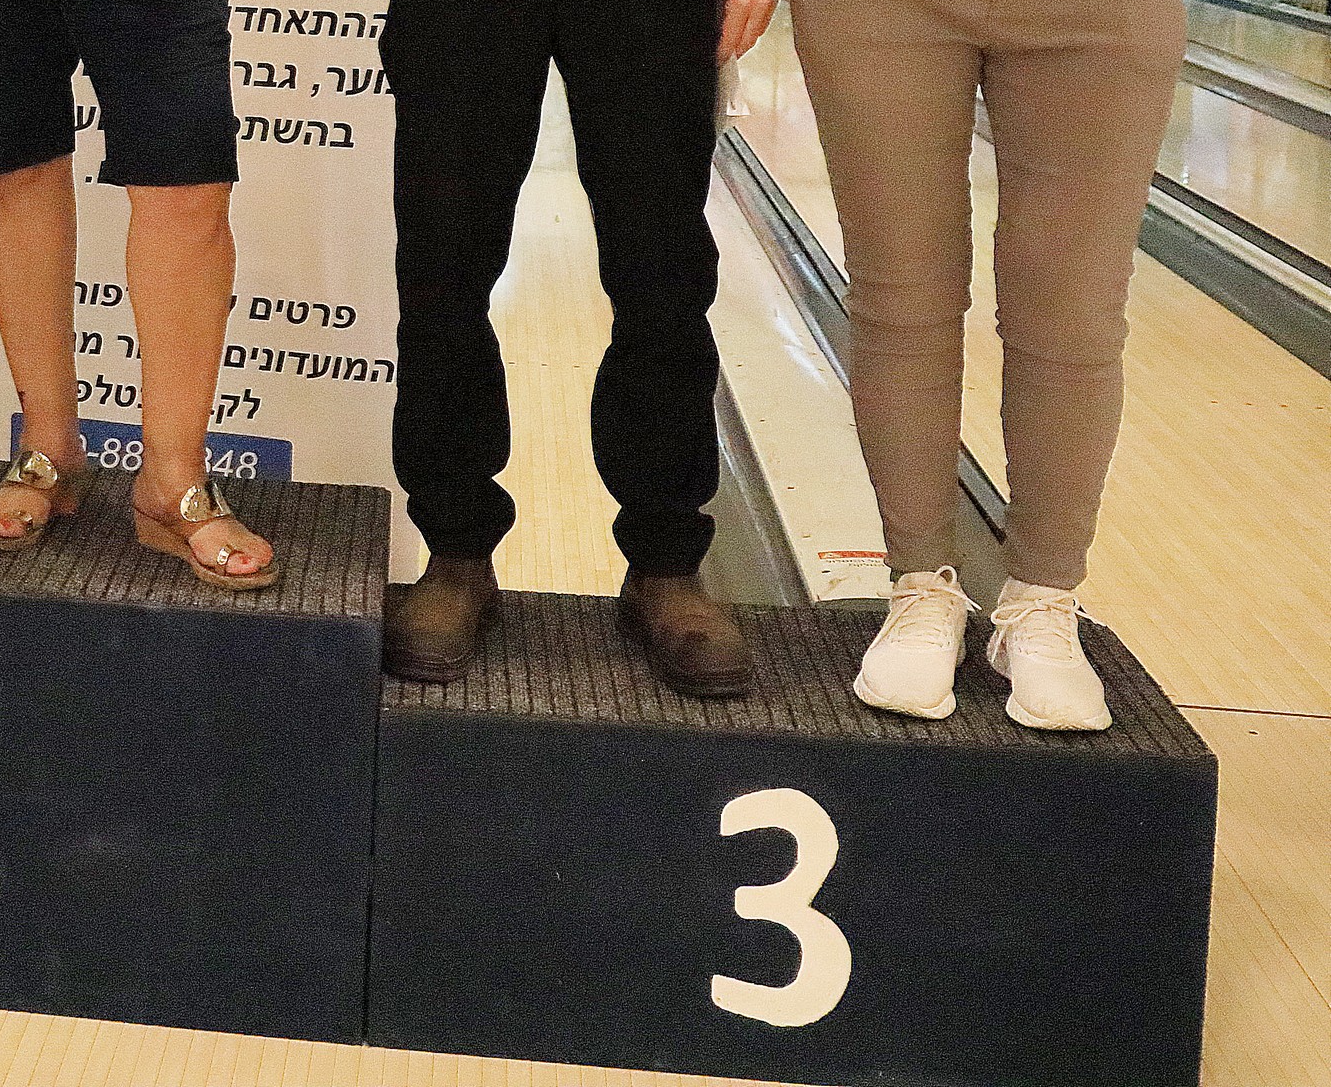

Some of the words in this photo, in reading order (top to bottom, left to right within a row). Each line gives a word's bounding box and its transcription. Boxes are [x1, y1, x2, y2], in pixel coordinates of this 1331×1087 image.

[250, 297, 356, 329] פרטים
[224, 344, 395, 383] המועדונים
[711, 787, 852, 1027] 3
